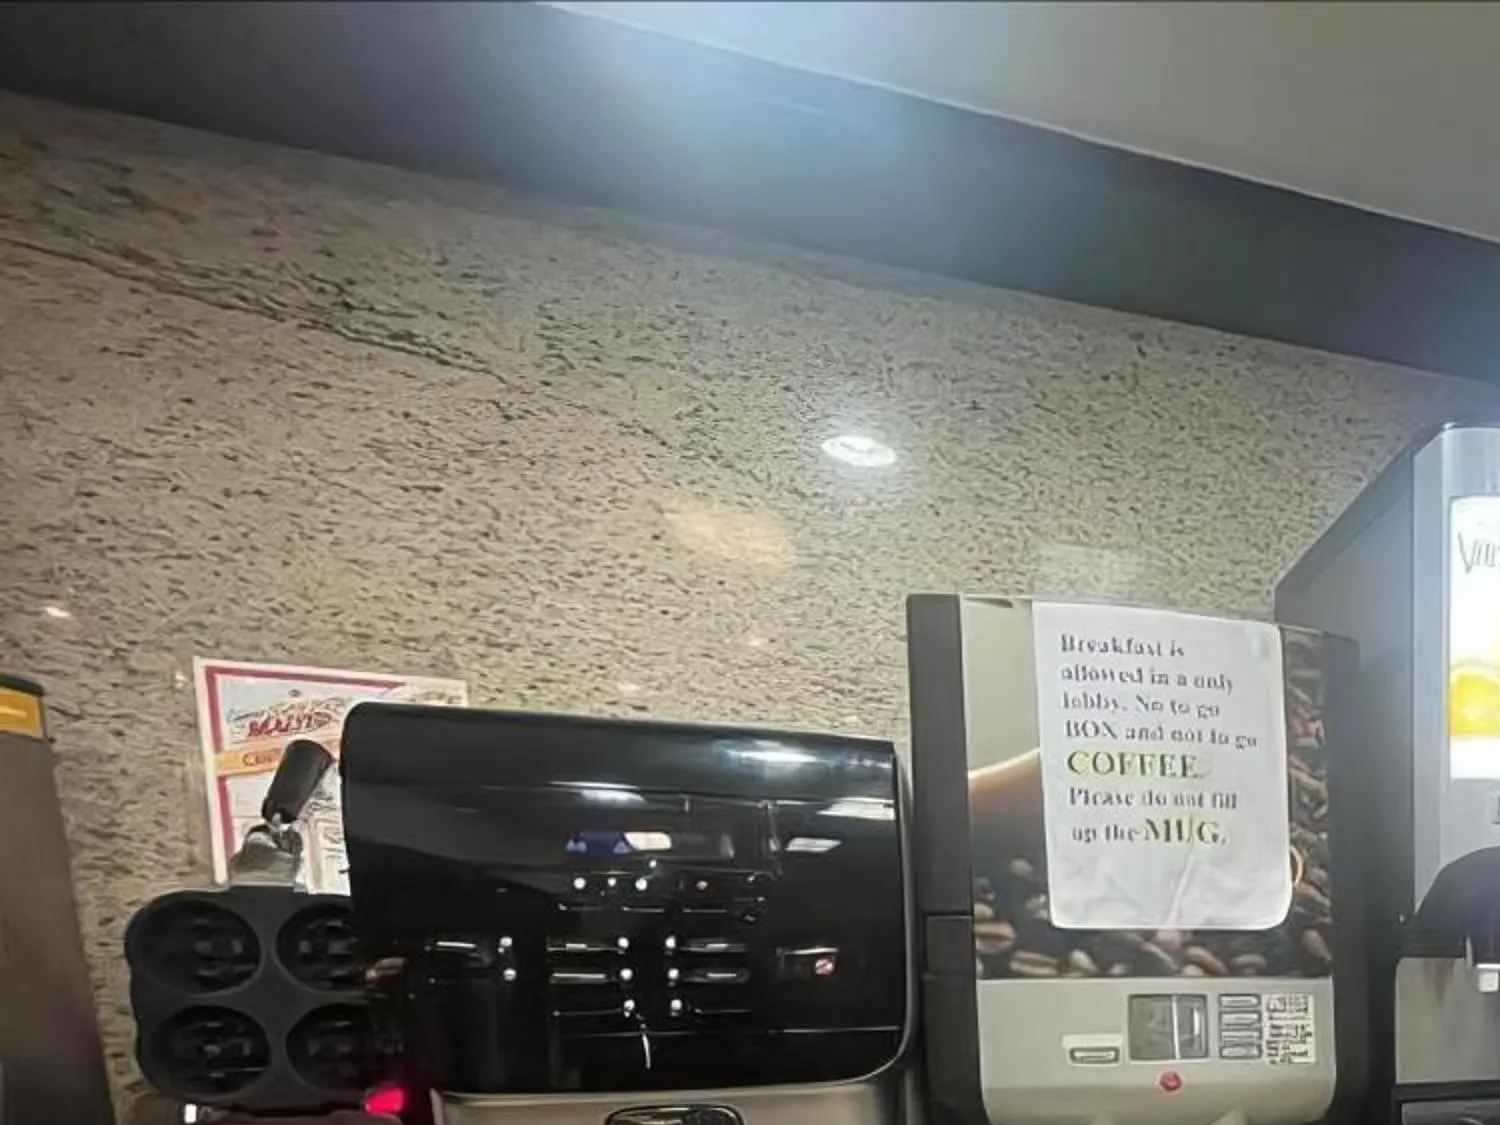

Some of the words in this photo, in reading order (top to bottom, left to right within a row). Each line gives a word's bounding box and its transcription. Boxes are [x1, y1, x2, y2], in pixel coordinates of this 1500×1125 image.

[1061, 633, 1163, 658] Breakfast
[1169, 639, 1185, 657] is
[1060, 663, 1144, 684] allowed
[1150, 668, 1170, 686] in
[1176, 672, 1188, 687] a
[1193, 674, 1233, 697] only
[1062, 691, 1128, 712] lobby.
[1135, 693, 1165, 713] No
[1169, 698, 1191, 715] to
[1196, 702, 1220, 719] go
[1065, 719, 1119, 740] BOX
[1125, 725, 1165, 741] and
[1170, 729, 1203, 744] not
[1210, 728, 1230, 746] to
[1235, 734, 1258, 751] go
[1068, 786, 1135, 807] Please
[1143, 789, 1168, 808] do
[1173, 792, 1205, 809] not
[1211, 792, 1239, 811] fill
[1071, 827, 1098, 845] up
[1104, 823, 1138, 843] the
[1143, 817, 1229, 846] MUG.
